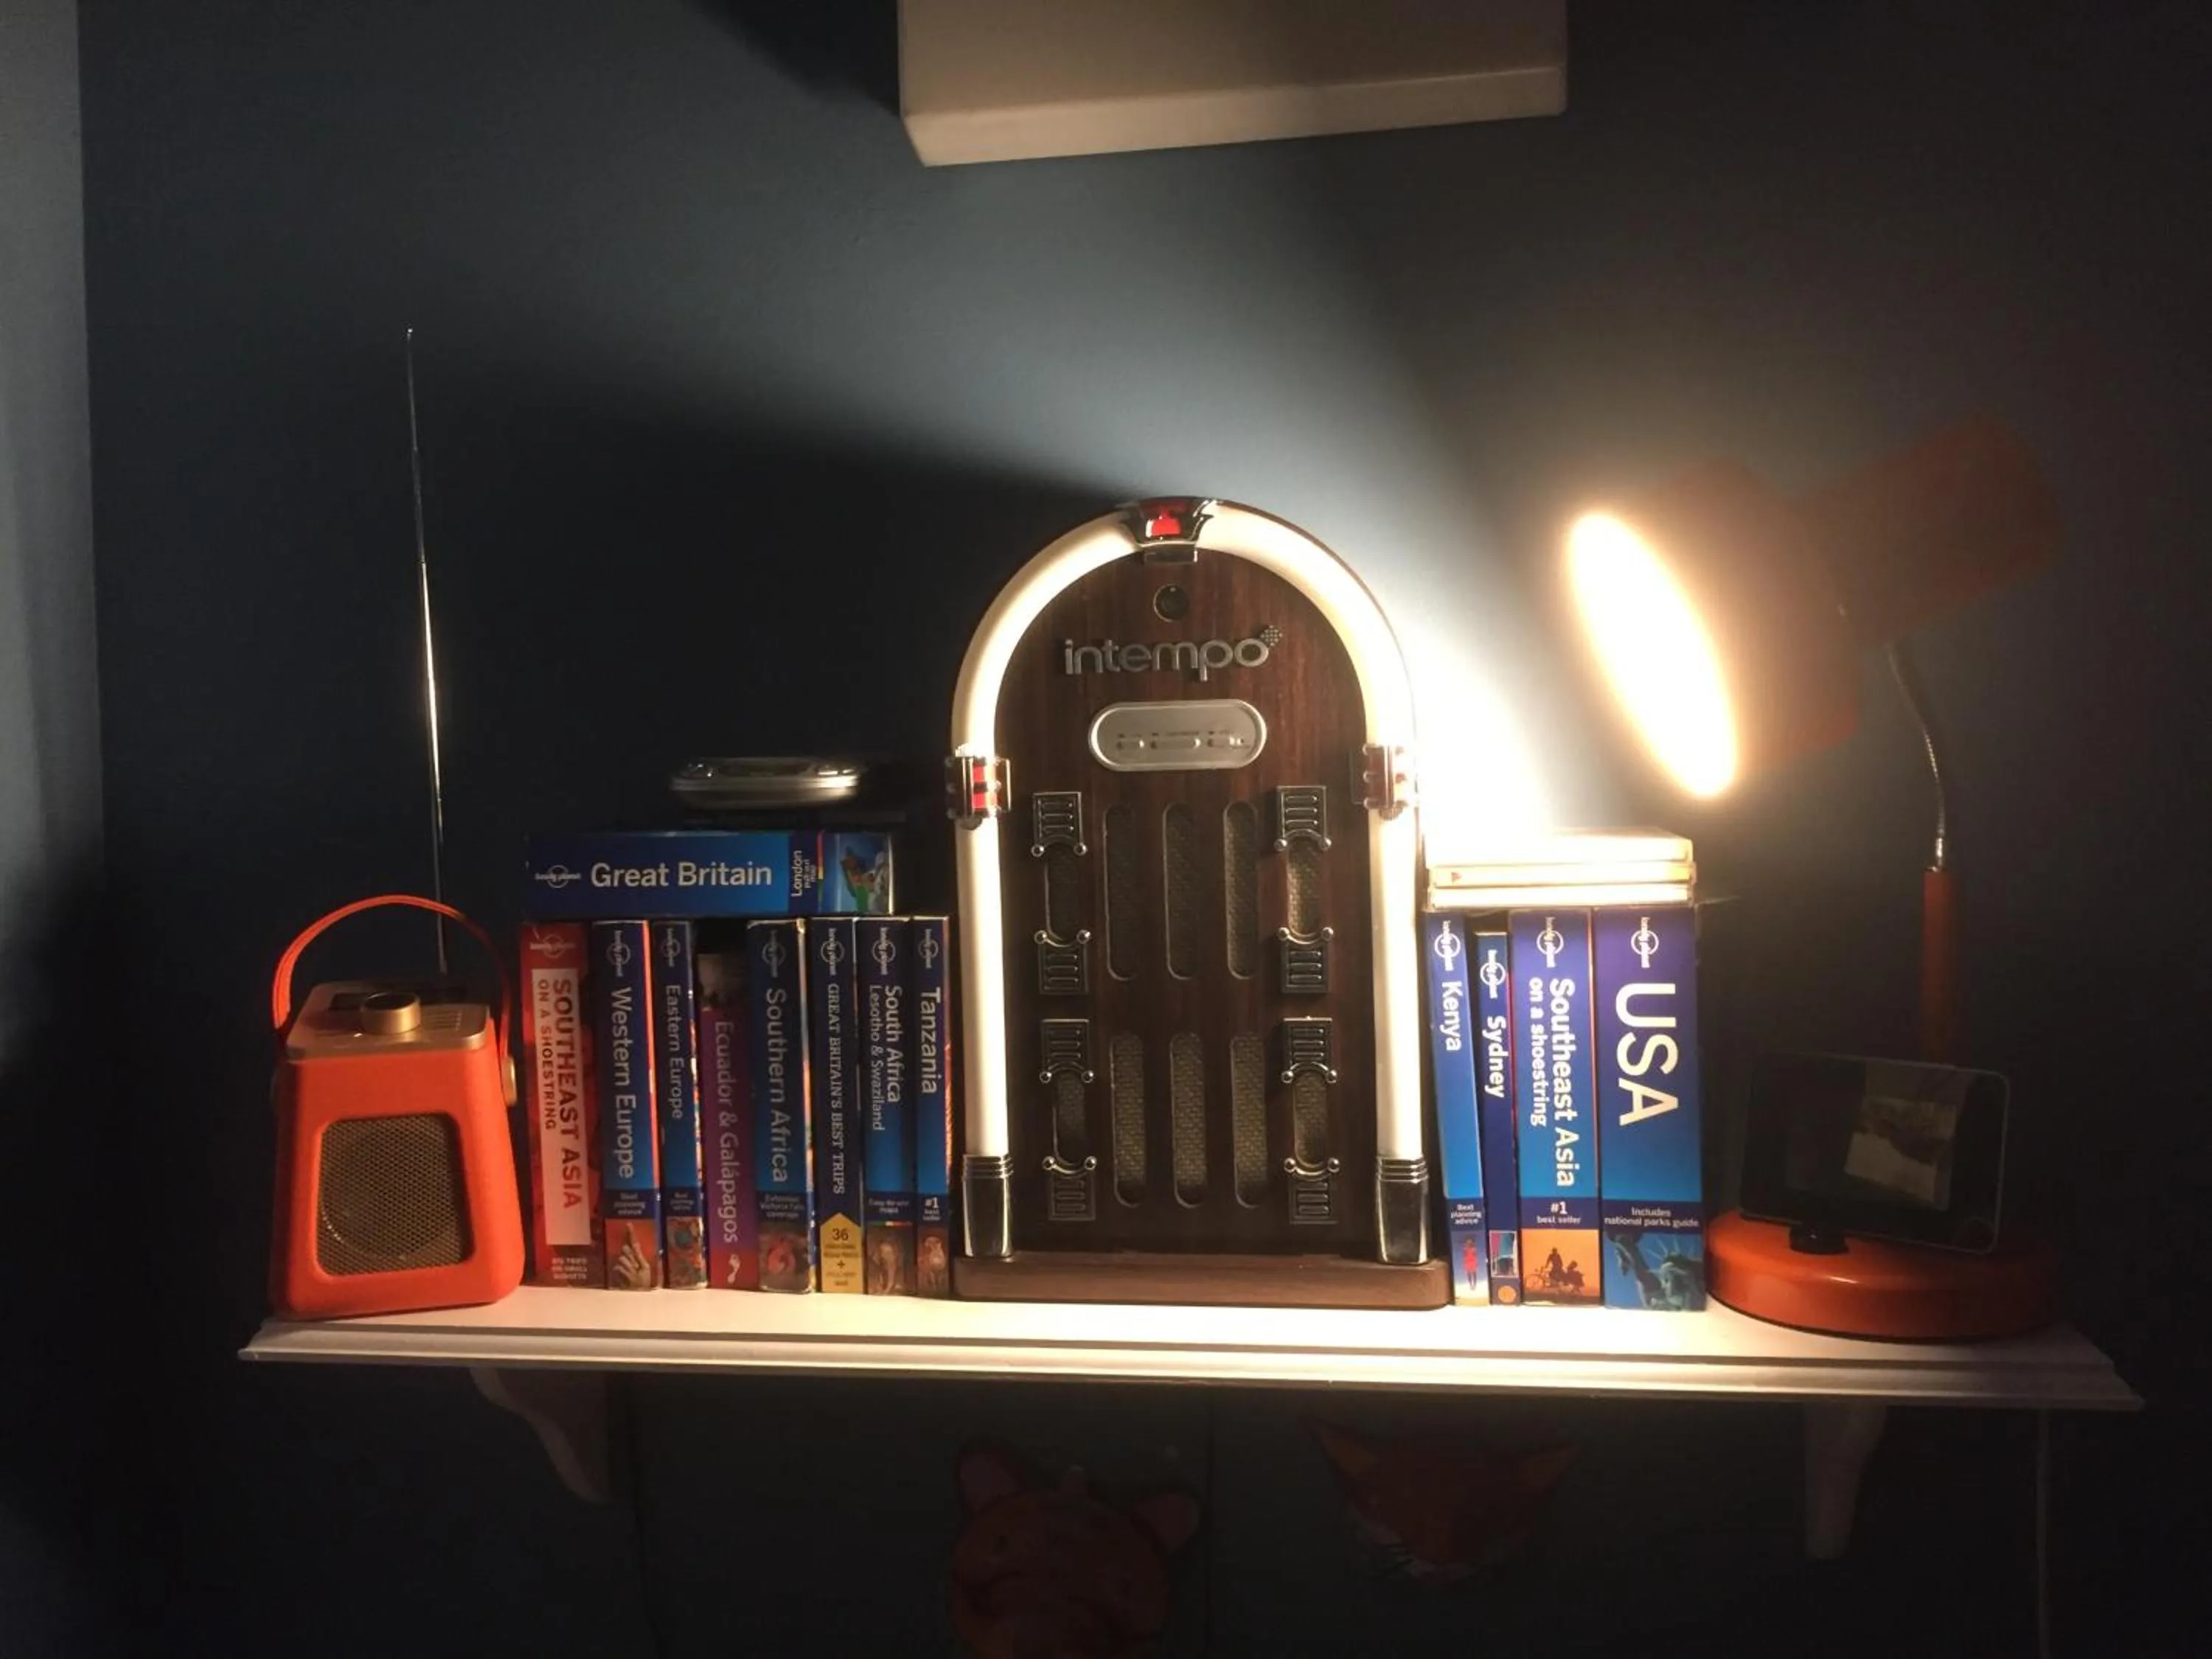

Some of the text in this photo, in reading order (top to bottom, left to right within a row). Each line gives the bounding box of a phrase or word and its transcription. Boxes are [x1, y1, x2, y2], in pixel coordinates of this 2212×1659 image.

[1065, 638, 1269, 681] intempo
[591, 860, 773, 887] Great Britain
[790, 849, 803, 897] London
[538, 978, 550, 1002] ON
[666, 985, 683, 1051] Eastern
[827, 984, 841, 1032] GREAT
[1440, 981, 1464, 1051] Kenya
[611, 987, 633, 1086] Western
[766, 988, 788, 1103] Southern
[869, 985, 885, 1130] Lesotho & Swaziland
[885, 985, 905, 1103] South Africa
[920, 987, 942, 1093] Tanzania
[1482, 1015, 1509, 1098] Sydney
[1529, 977, 1550, 1127] on a shoestring
[1615, 983, 1679, 1127] USA
[540, 1026, 557, 1130] SHOESTRING
[554, 979, 582, 1209] SOUTHEAST ASIA
[667, 1057, 685, 1119] Europe
[1550, 978, 1580, 1186] Southeast Asia
[613, 1094, 636, 1178] Europe
[715, 1021, 741, 1243] Ecuador & Galápagos
[771, 1108, 792, 1183] Africa
[831, 1113, 844, 1147] BEST
[832, 1151, 845, 1195] TRIPS
[1551, 1201, 1568, 1214] #1
[832, 1228, 849, 1241] 36
[1537, 1215, 1581, 1224] best seller
[1604, 1217, 1700, 1229] national parks guide
[1631, 1206, 1671, 1217] Includes
